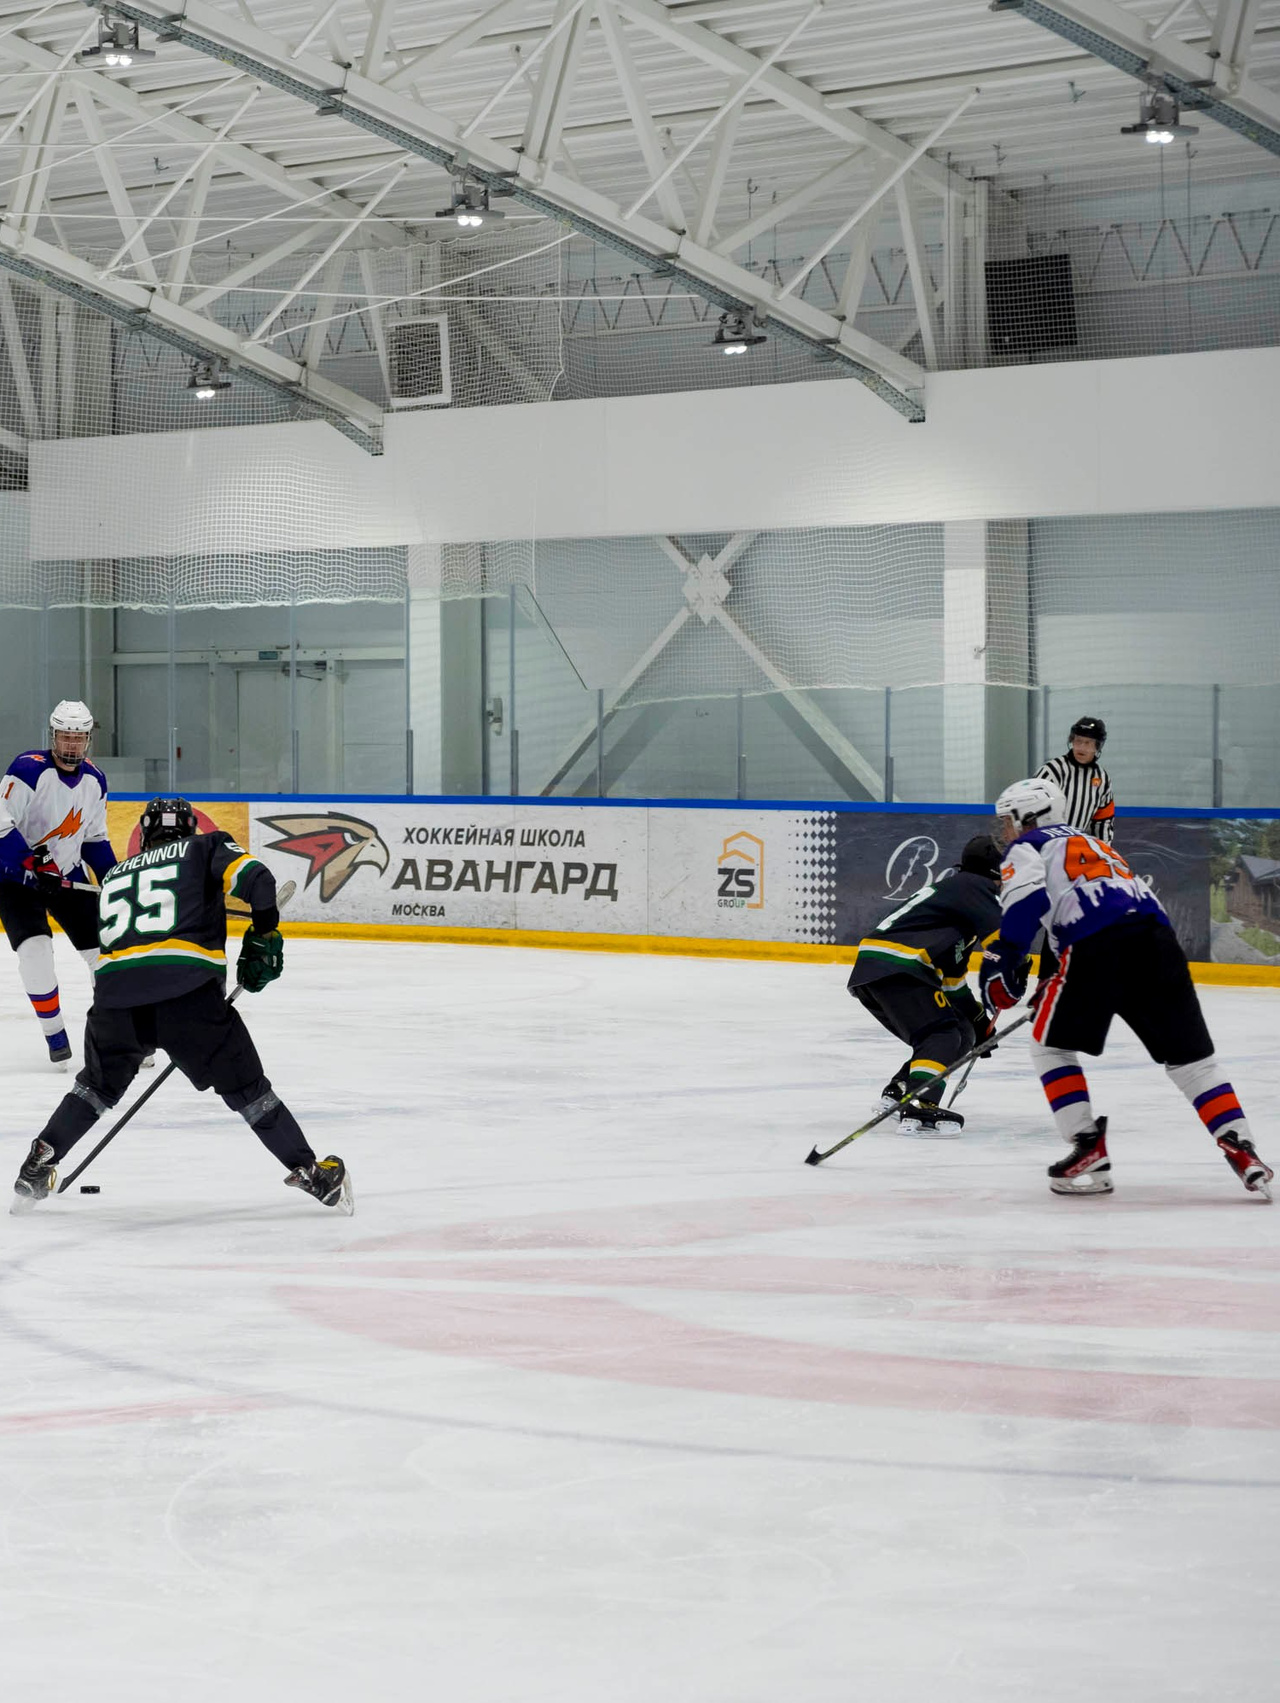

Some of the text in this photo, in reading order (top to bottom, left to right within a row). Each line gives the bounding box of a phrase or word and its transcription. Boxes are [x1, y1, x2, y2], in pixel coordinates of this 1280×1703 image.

[403, 825, 586, 848] ХОККЕЙНАЯ ШКОЛА
[391, 858, 618, 901] АВАНГАРД
[717, 868, 755, 897] ZS
[100, 864, 180, 947] 55
[391, 904, 446, 917] МОСКВА
[717, 899, 745, 908] GROUP
